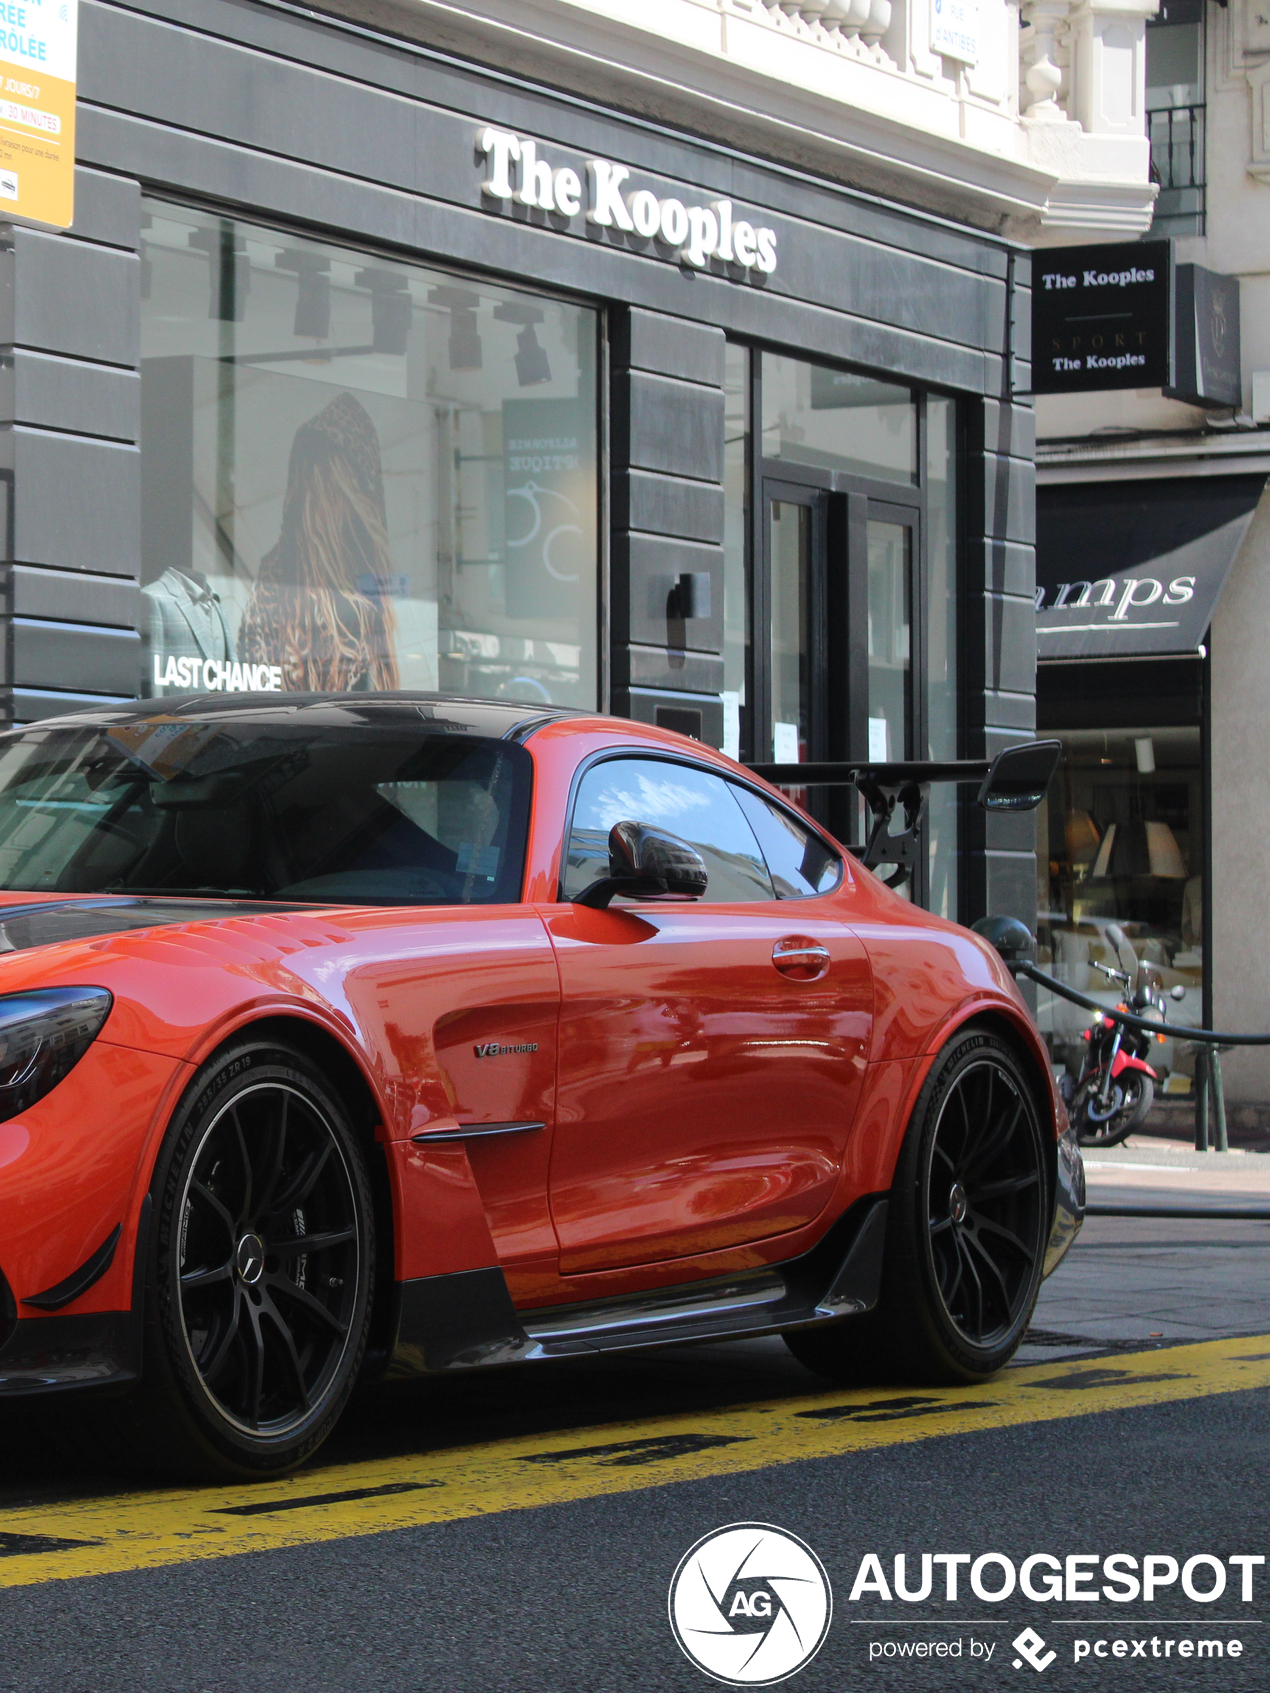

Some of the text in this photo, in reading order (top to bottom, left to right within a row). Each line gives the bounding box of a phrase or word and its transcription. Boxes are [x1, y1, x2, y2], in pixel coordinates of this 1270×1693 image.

[4, 77, 41, 99] JOURS/7
[8, 105, 18, 119] 30
[21, 109, 57, 131] MINUTES
[0, 136, 21, 150] livraison
[479, 127, 777, 274] The Kooples
[1042, 267, 1155, 290] The Kooples
[1052, 331, 1146, 351] SPORT
[1052, 353, 1145, 371] The Kooples
[154, 655, 282, 692] LAST CHANCE
[475, 1042, 538, 1058] V8 BITURBO
[947, 1037, 984, 1070] MICHELIN
[159, 1122, 195, 1247] MICHELIN
[197, 1072, 227, 1114] 285/35
